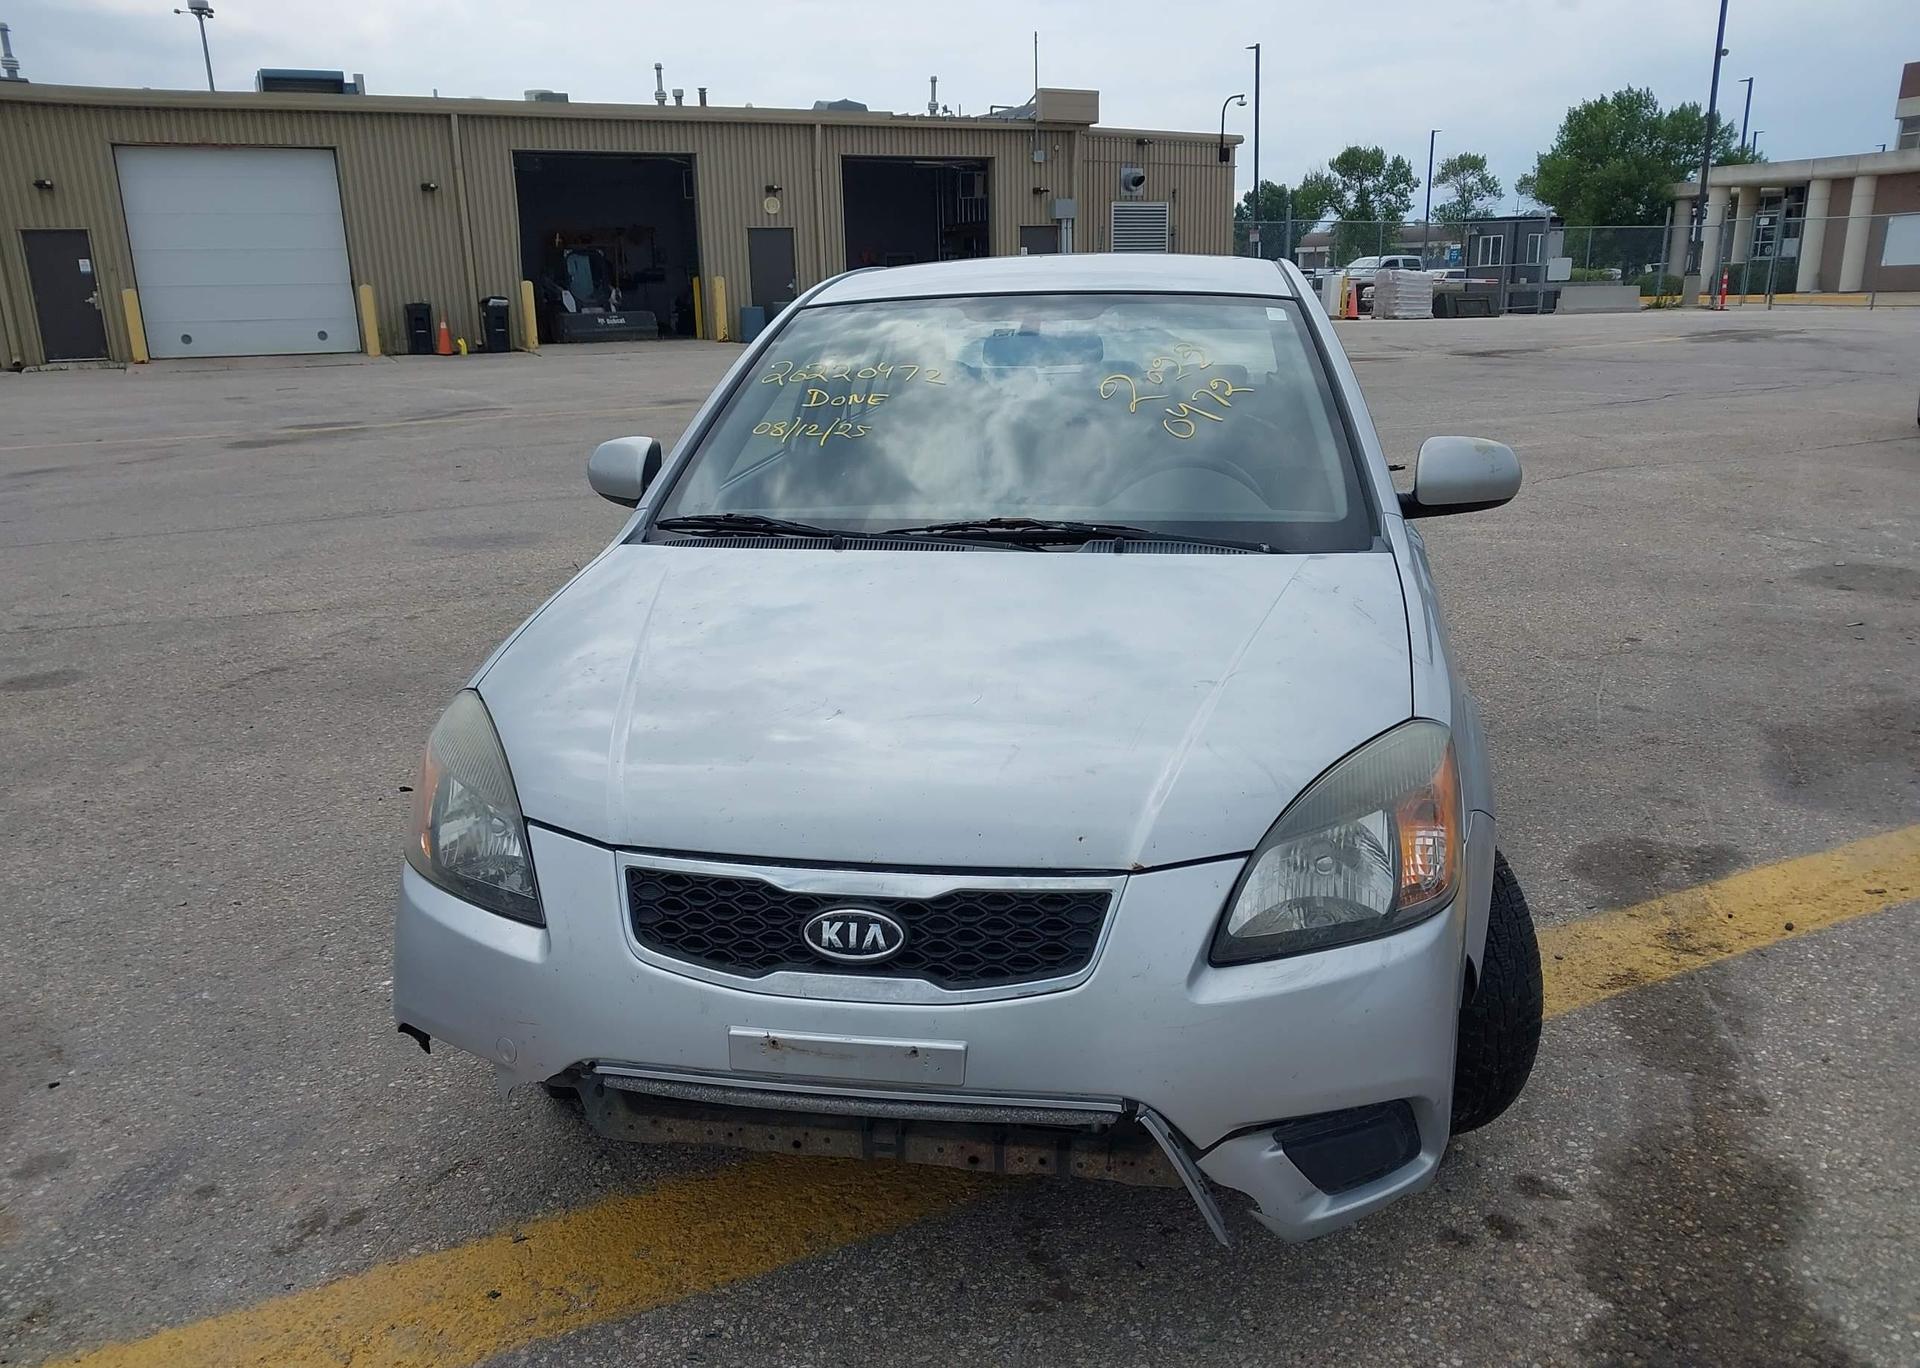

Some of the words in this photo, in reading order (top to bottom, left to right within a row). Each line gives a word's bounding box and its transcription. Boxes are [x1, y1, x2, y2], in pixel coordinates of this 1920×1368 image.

[761, 360, 946, 386] 20220472
[802, 388, 889, 407] DONE
[1163, 378, 1255, 439] 0472
[752, 417, 872, 446] 08/12/25
[821, 920, 887, 950] KIA
